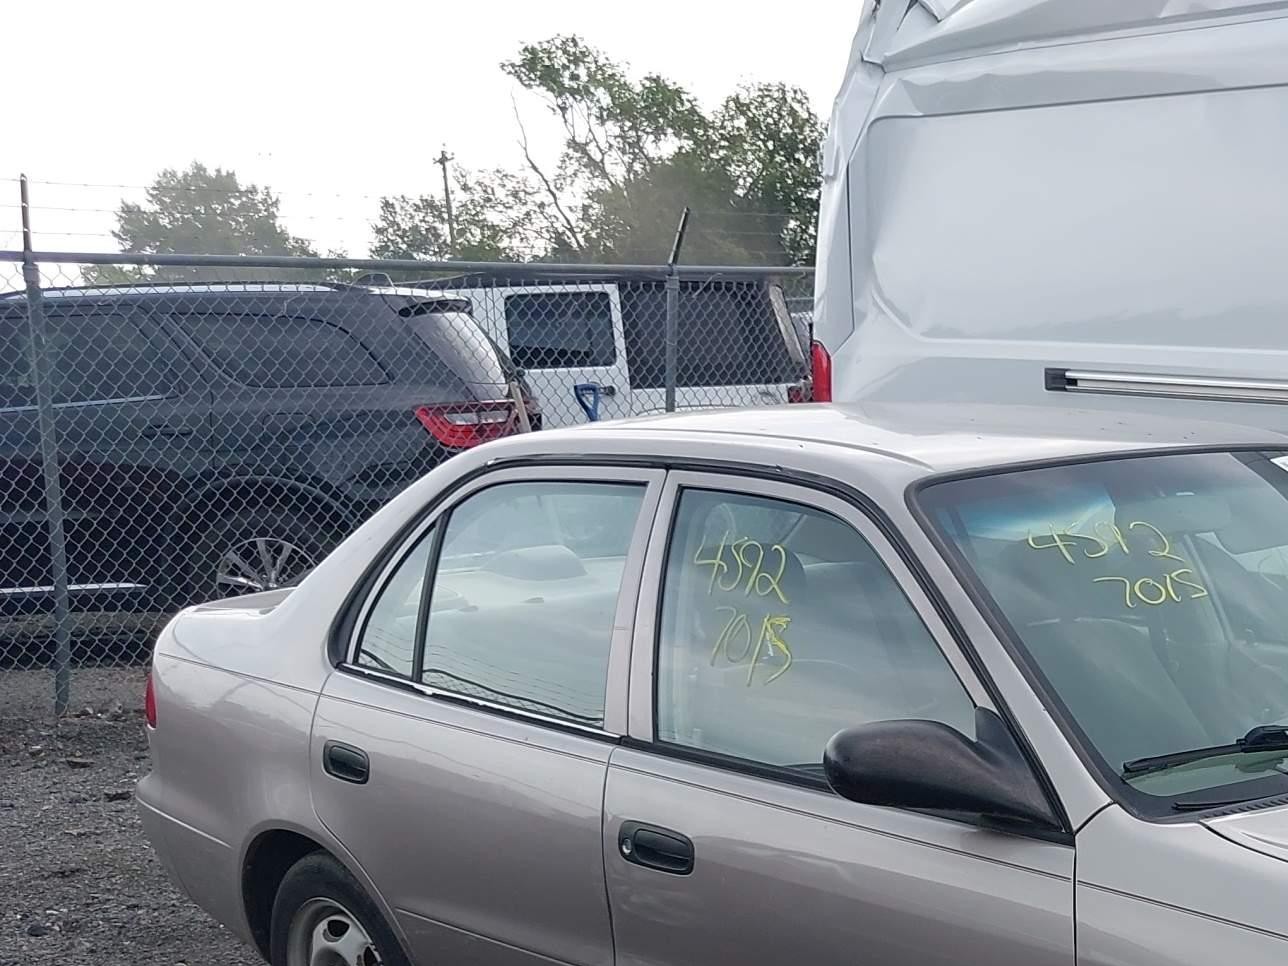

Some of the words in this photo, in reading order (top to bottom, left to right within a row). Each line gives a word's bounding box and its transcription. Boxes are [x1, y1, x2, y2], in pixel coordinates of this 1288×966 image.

[1027, 520, 1186, 565] 4592
[693, 530, 790, 605] 4592
[1093, 568, 1209, 609] 7015
